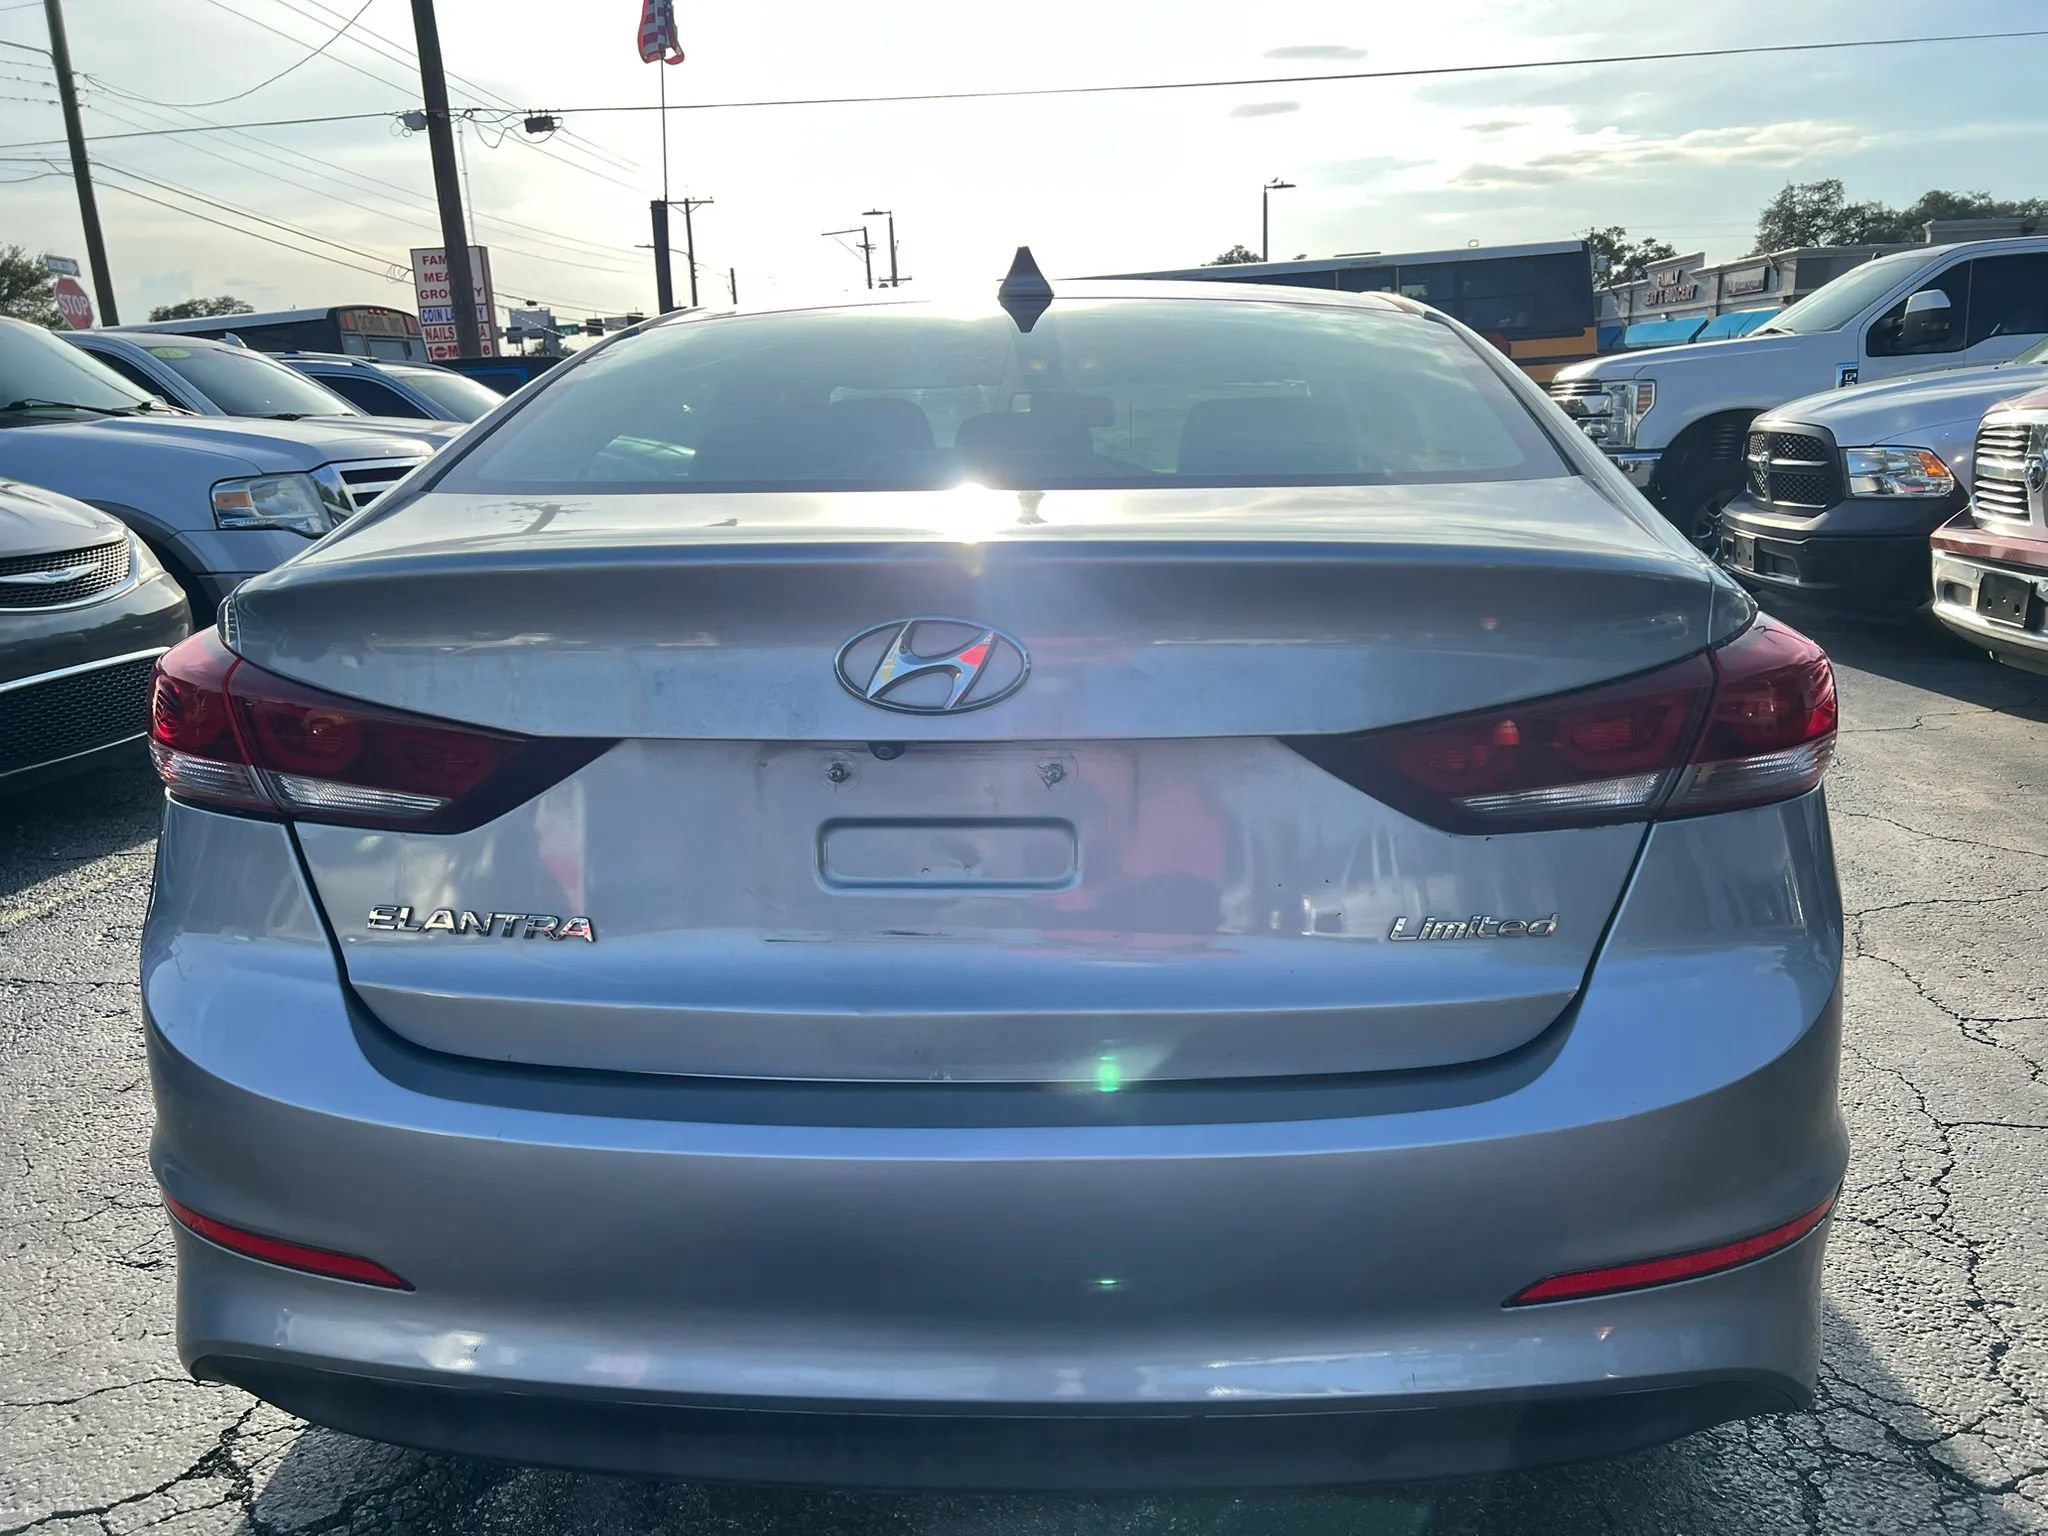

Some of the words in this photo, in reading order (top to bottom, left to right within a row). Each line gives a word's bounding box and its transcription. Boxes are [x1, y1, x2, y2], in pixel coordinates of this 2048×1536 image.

[422, 255, 447, 266] FAM
[424, 272, 450, 283] MEA
[58, 293, 88, 317] STOP
[422, 308, 443, 323] COIN
[425, 326, 455, 341] NAILS
[367, 904, 597, 944] ELANTRA
[1389, 912, 1560, 942] Limited
